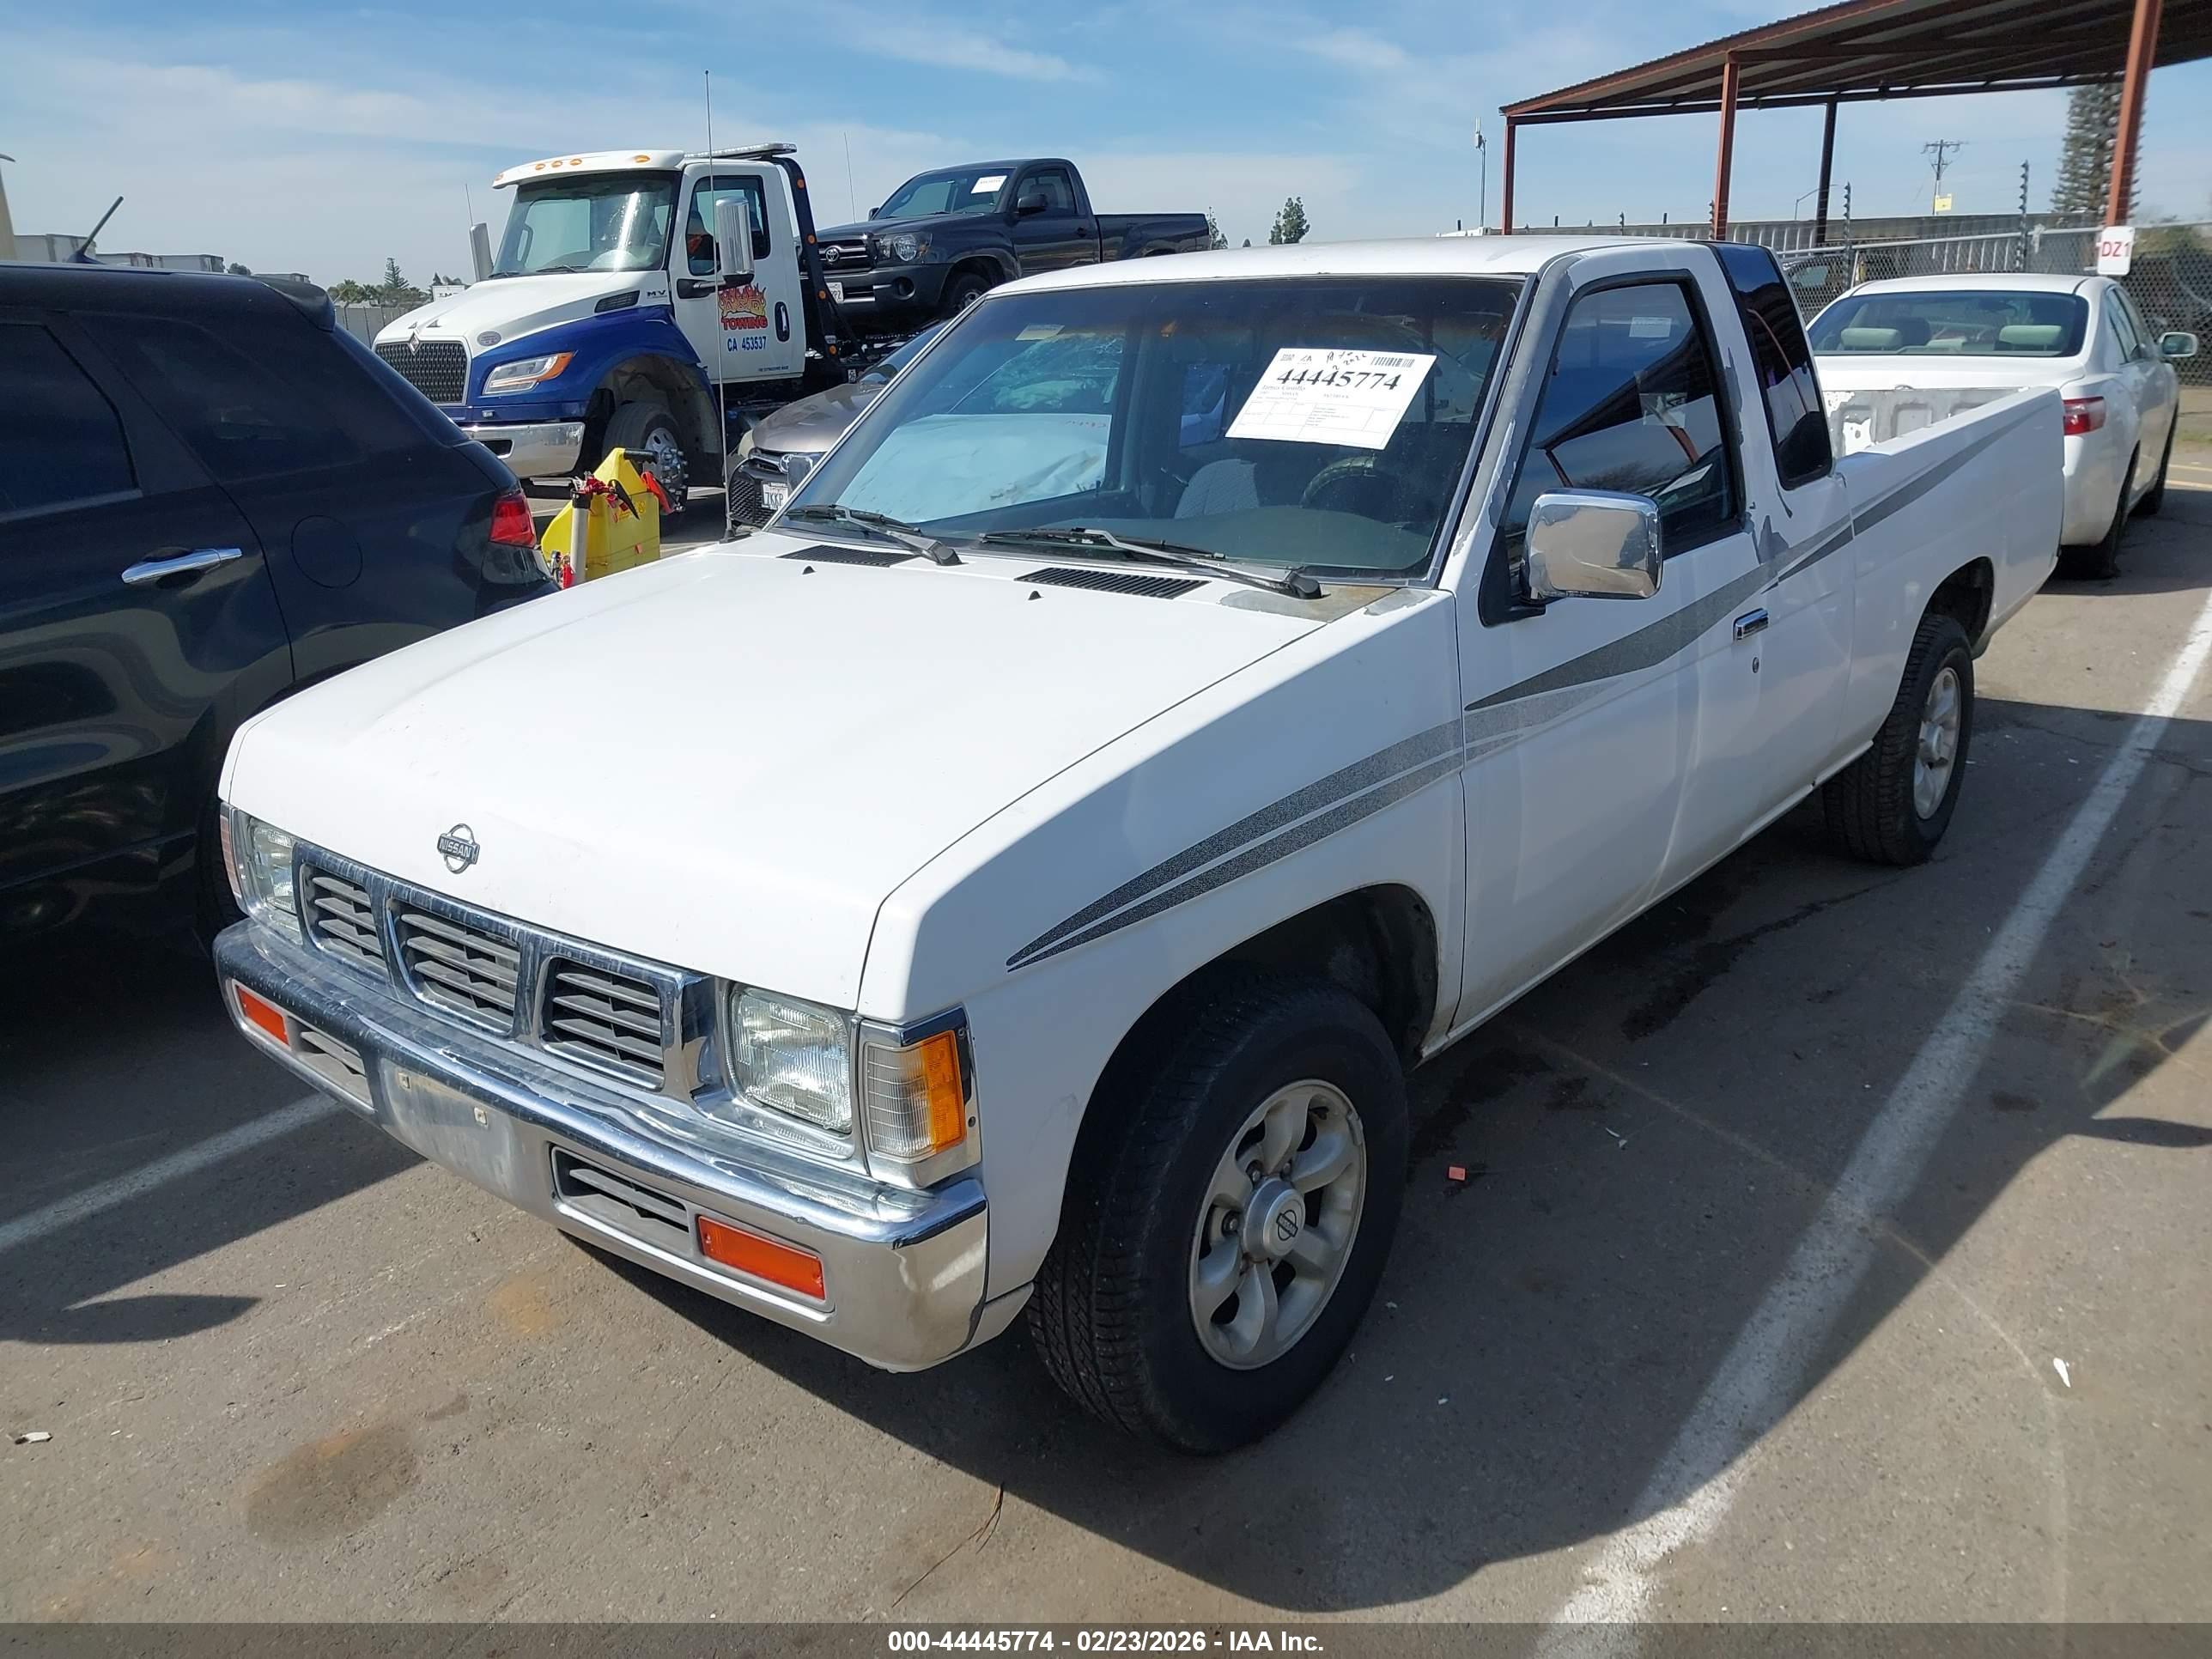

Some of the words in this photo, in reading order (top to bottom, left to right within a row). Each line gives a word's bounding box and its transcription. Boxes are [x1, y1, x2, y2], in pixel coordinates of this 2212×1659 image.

[2101, 240, 2130, 258] DZ1
[720, 315, 769, 331] TOWING
[726, 337, 738, 352] CA
[741, 336, 767, 351] 453537
[1276, 368, 1402, 391] 44445774
[439, 836, 472, 859] NISSAN
